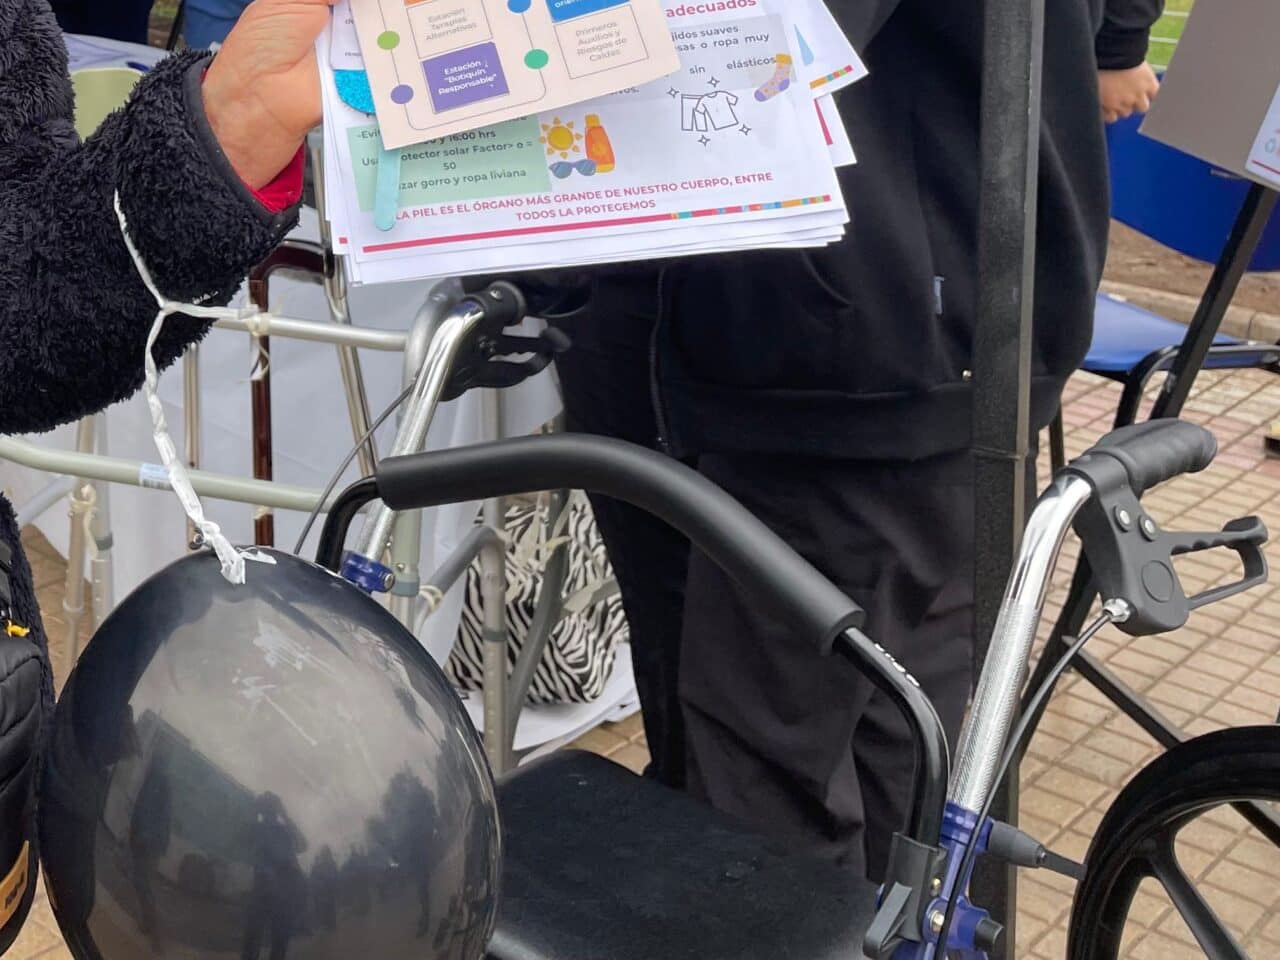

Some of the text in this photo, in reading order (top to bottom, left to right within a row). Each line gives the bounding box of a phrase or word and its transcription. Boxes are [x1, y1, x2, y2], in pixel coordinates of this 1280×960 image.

[713, 38, 739, 49] ropa
[744, 34, 770, 44] muy
[443, 60, 482, 76] Estación
[689, 56, 777, 75] sin elásticos
[478, 130, 496, 139] hrs
[443, 146, 470, 157] solar
[442, 161, 457, 170] 50
[421, 177, 450, 189] gorro
[453, 176, 460, 186] y
[462, 173, 488, 185] ropa
[490, 169, 527, 179] liviana
[412, 207, 439, 219] PIEL
[440, 205, 454, 215] ES
[456, 203, 471, 213] EL
[473, 198, 524, 212] ÓRGANO
[526, 193, 551, 205] MÁS
[553, 191, 603, 204] GRANDE
[605, 189, 621, 199] DE
[623, 183, 678, 197] NUESTRO
[680, 177, 733, 190] CUERPO,
[735, 172, 774, 185] ENTRE
[516, 199, 657, 222] TODOS LA PROTEGEMOS
